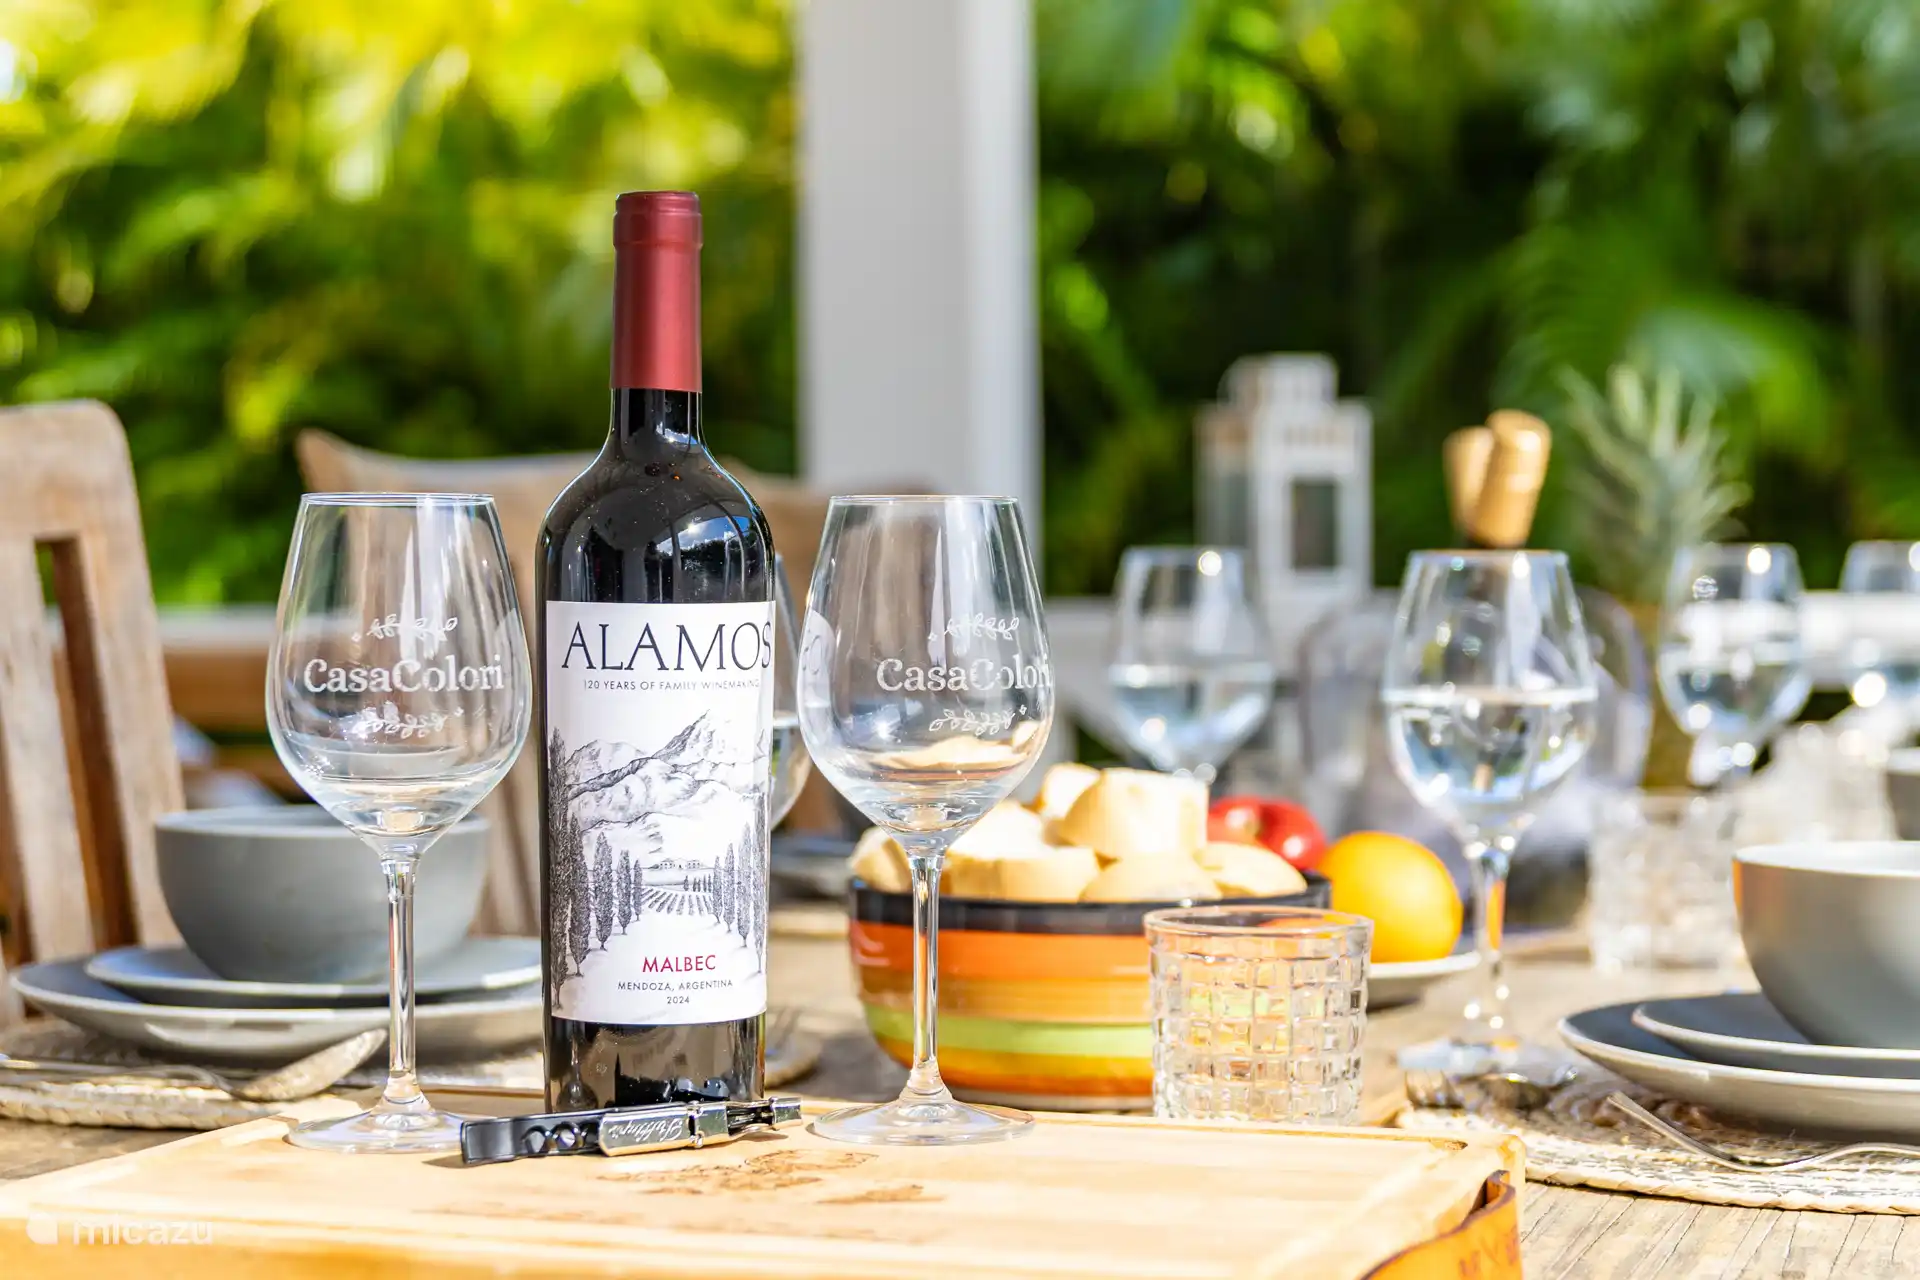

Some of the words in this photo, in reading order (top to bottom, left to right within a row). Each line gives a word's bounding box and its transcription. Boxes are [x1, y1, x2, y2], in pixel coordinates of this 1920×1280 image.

[561, 620, 772, 673] ALAMOS
[303, 654, 505, 694] CasaColori
[583, 680, 600, 690] 120
[603, 680, 636, 690] YEARS
[640, 680, 656, 691] OF
[659, 680, 697, 691] FAMILY
[701, 678, 761, 690] WINEMAKING
[642, 954, 717, 973] MALBEC
[617, 981, 675, 992] MENDOZA,
[678, 979, 734, 990] ARGENTINA
[666, 996, 690, 1005] 2024
